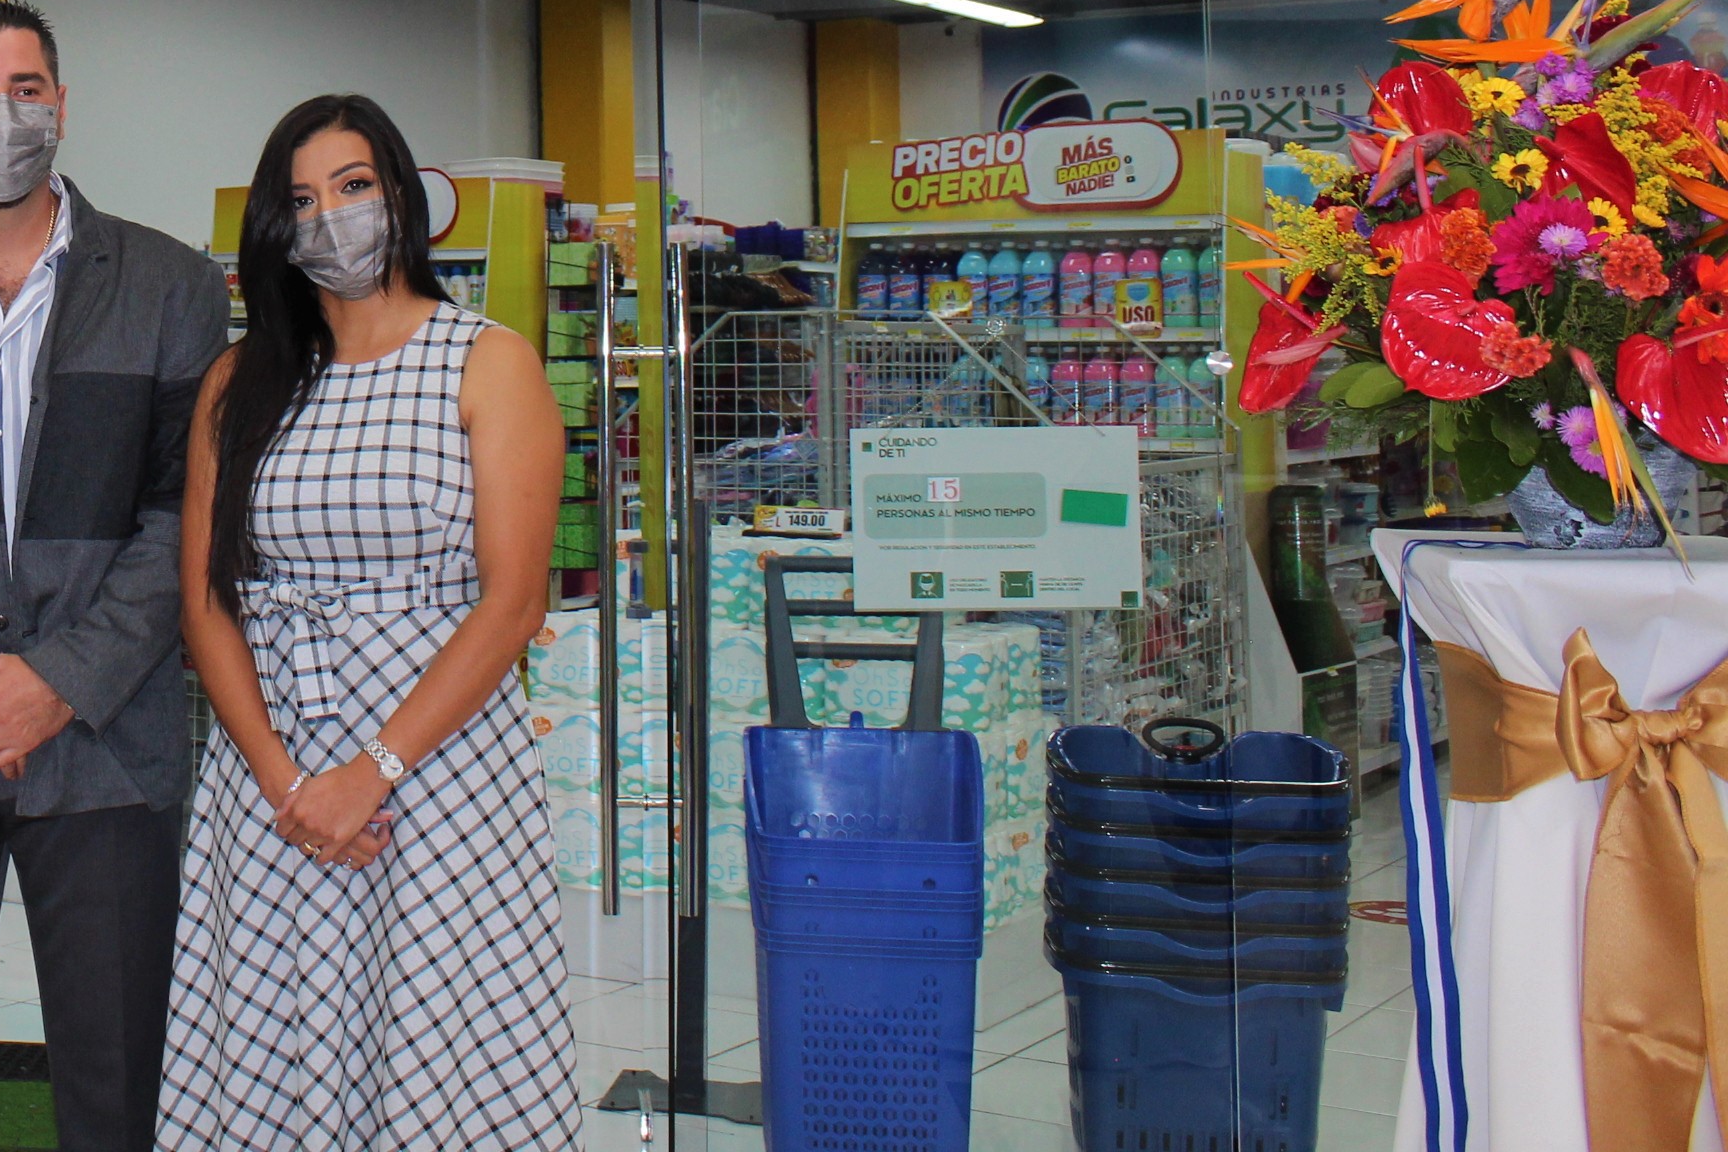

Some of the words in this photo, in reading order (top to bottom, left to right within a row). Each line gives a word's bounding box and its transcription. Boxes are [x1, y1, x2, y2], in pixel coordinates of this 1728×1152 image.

[1212, 83, 1347, 102] INDUSTRIAS
[893, 130, 1024, 178] PRECIO
[1061, 134, 1114, 166] MÁS
[1056, 155, 1120, 184] BARATO
[892, 164, 1029, 210] OFERTA
[1065, 174, 1115, 197] NADIE!
[1122, 305, 1155, 324] USO
[878, 437, 937, 448] CUIDANDO
[878, 449, 894, 458] DE
[896, 449, 905, 458] TI
[876, 492, 922, 503] MÁXIMO
[928, 479, 959, 500] 15
[788, 514, 825, 527] 149.00
[876, 508, 935, 519] PERSONAS
[938, 509, 952, 518] AL
[954, 508, 991, 518] MISMO
[994, 507, 1036, 518] TIEMPO
